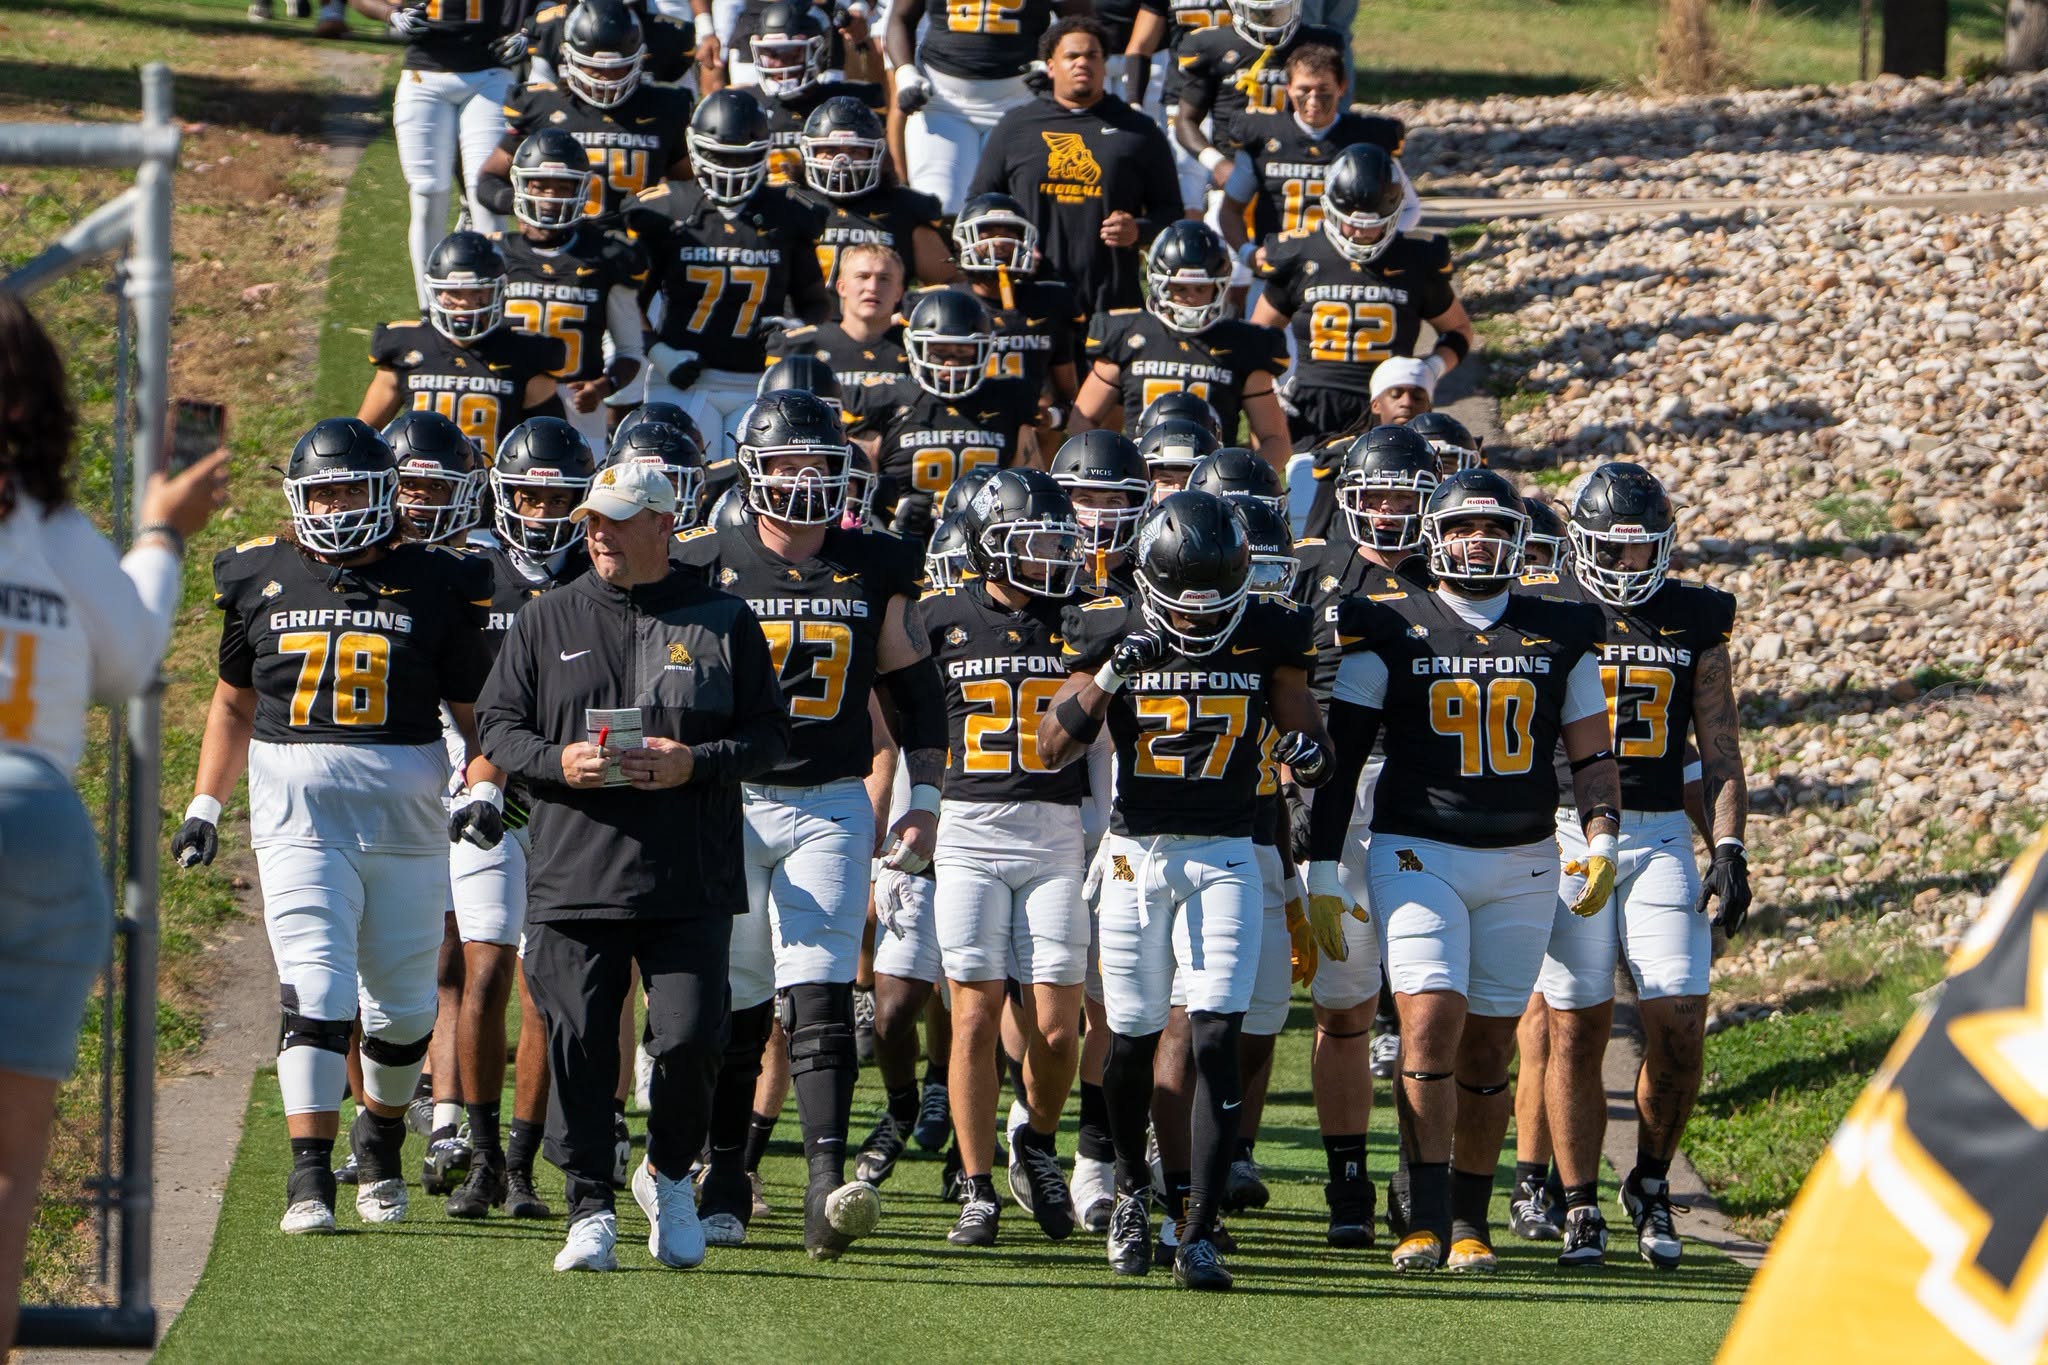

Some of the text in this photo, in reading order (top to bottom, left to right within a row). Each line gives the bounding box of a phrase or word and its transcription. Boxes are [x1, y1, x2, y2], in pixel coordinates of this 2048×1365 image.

[571, 132, 660, 148] RIFFONS
[679, 247, 781, 264] GRIFFONS
[685, 265, 770, 338] 77
[1304, 285, 1408, 304] GRIFFONS
[1309, 301, 1397, 362] 82
[1132, 360, 1232, 384] GRIFFONS
[408, 375, 514, 395] GRIFFONS
[900, 430, 1005, 448] GRIFFONS
[1090, 468, 1112, 476] VICIS
[1248, 544, 1278, 552] Riddell
[746, 598, 868, 617] RIFFONS
[270, 609, 412, 633] GRIFFONS
[948, 656, 1072, 679] GRIFFON
[1412, 656, 1550, 675] GRIFFONS
[278, 631, 391, 726] 78
[1125, 671, 1261, 691] GRIFFONS
[1134, 695, 1251, 780] 27
[1429, 678, 1537, 777] 90
